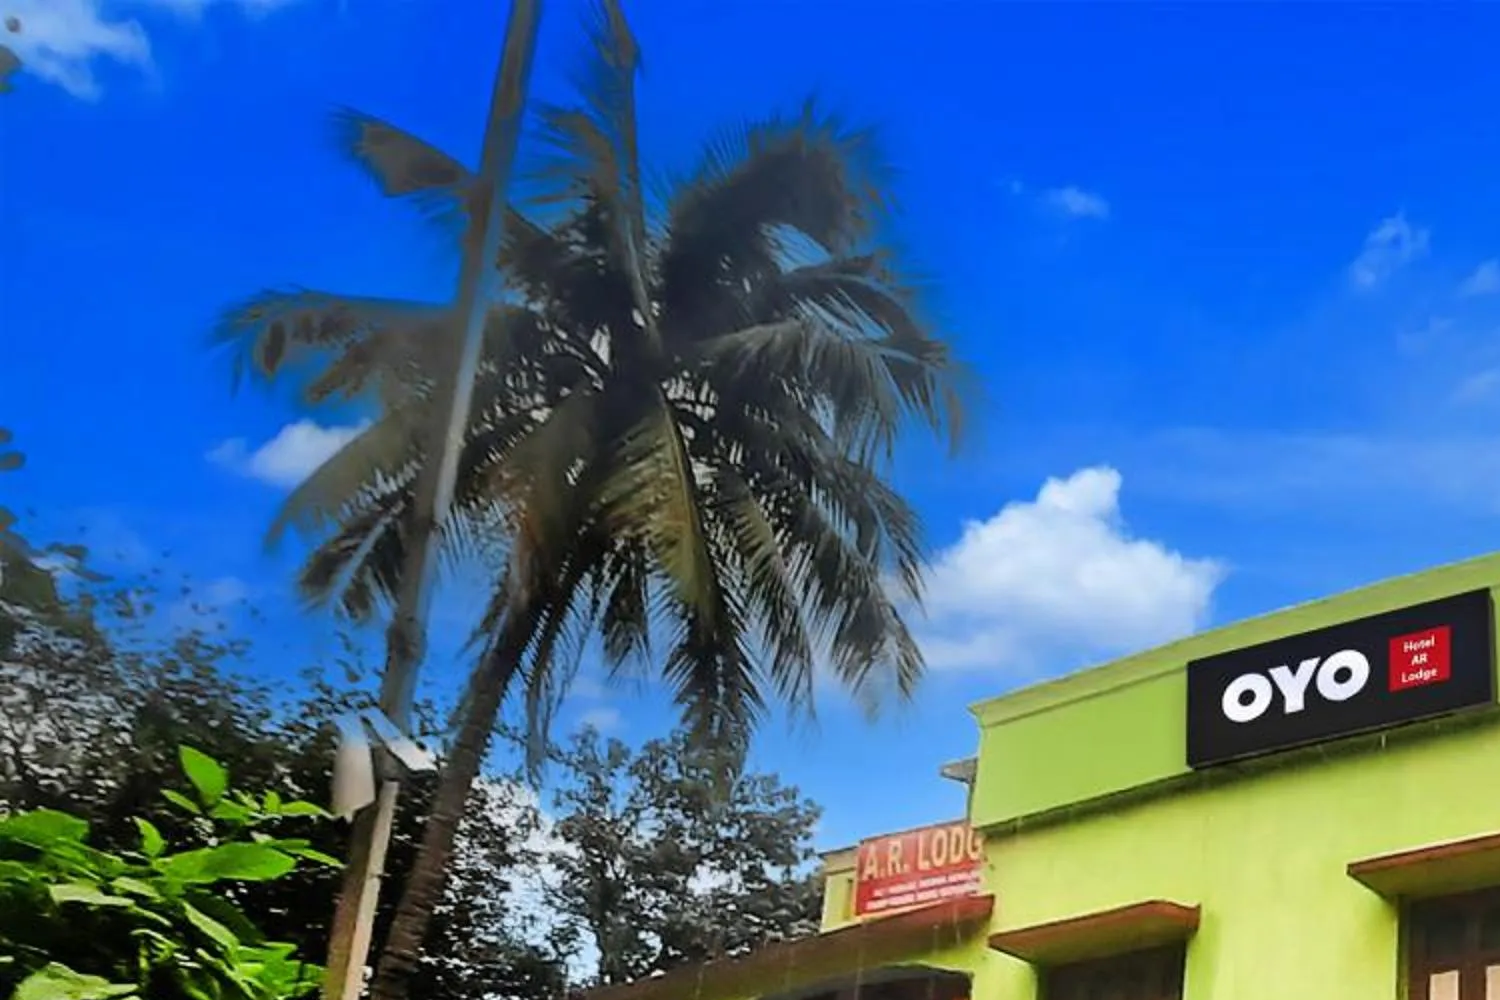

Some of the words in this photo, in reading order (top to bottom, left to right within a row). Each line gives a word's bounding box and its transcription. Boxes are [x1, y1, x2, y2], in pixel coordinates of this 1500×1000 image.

[1403, 635, 1435, 653] Hotel
[1411, 652, 1428, 667] AR
[1401, 668, 1438, 684] Lodge
[1221, 649, 1370, 723] OYO
[917, 825, 982, 871] LODG
